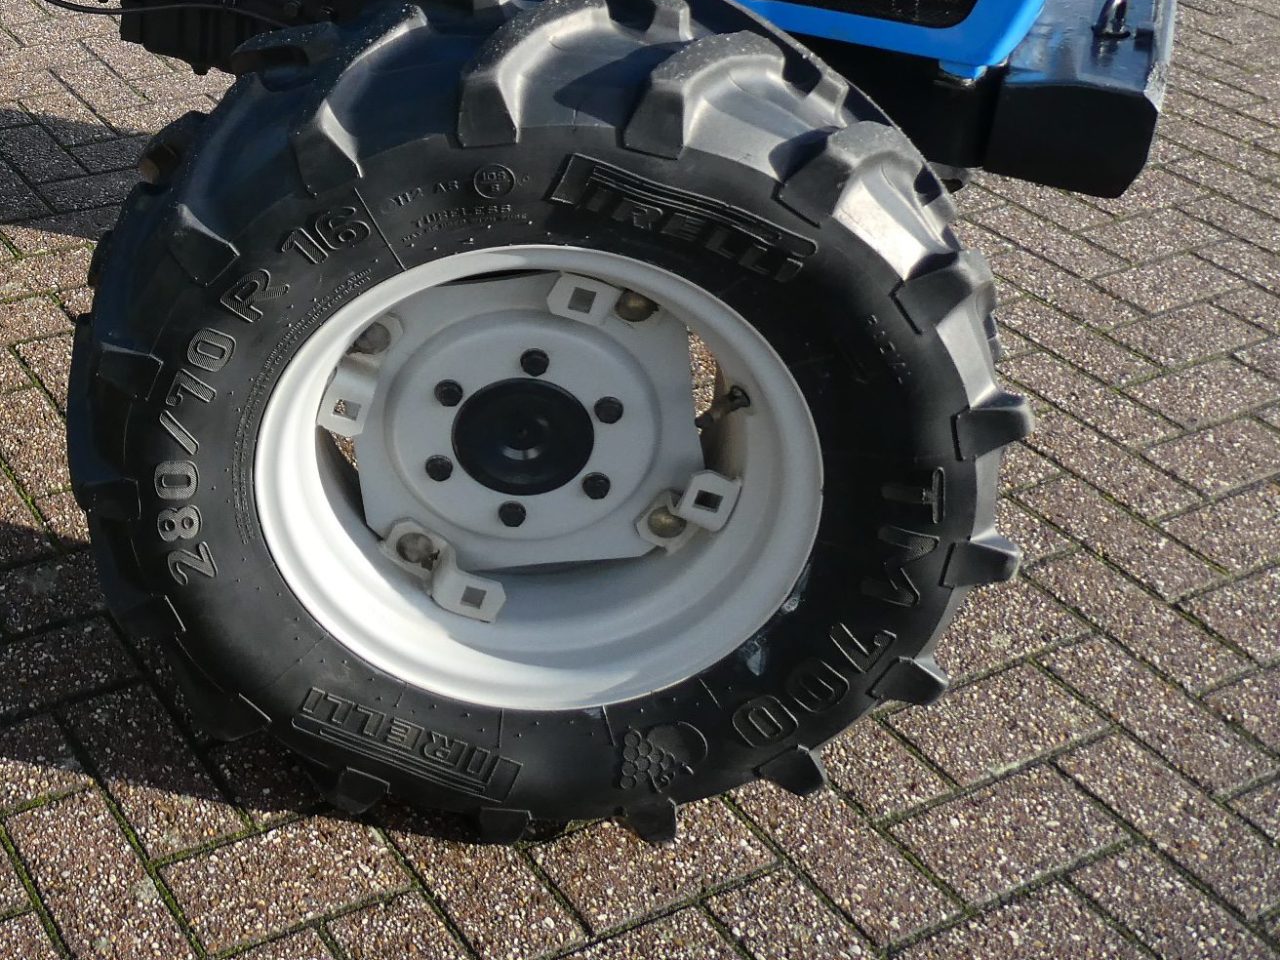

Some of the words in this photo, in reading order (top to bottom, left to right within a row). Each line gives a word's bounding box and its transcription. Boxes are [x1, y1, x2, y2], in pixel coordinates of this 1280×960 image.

[154, 325, 238, 587] 280/70
[219, 268, 290, 324] R
[280, 206, 374, 266] 16
